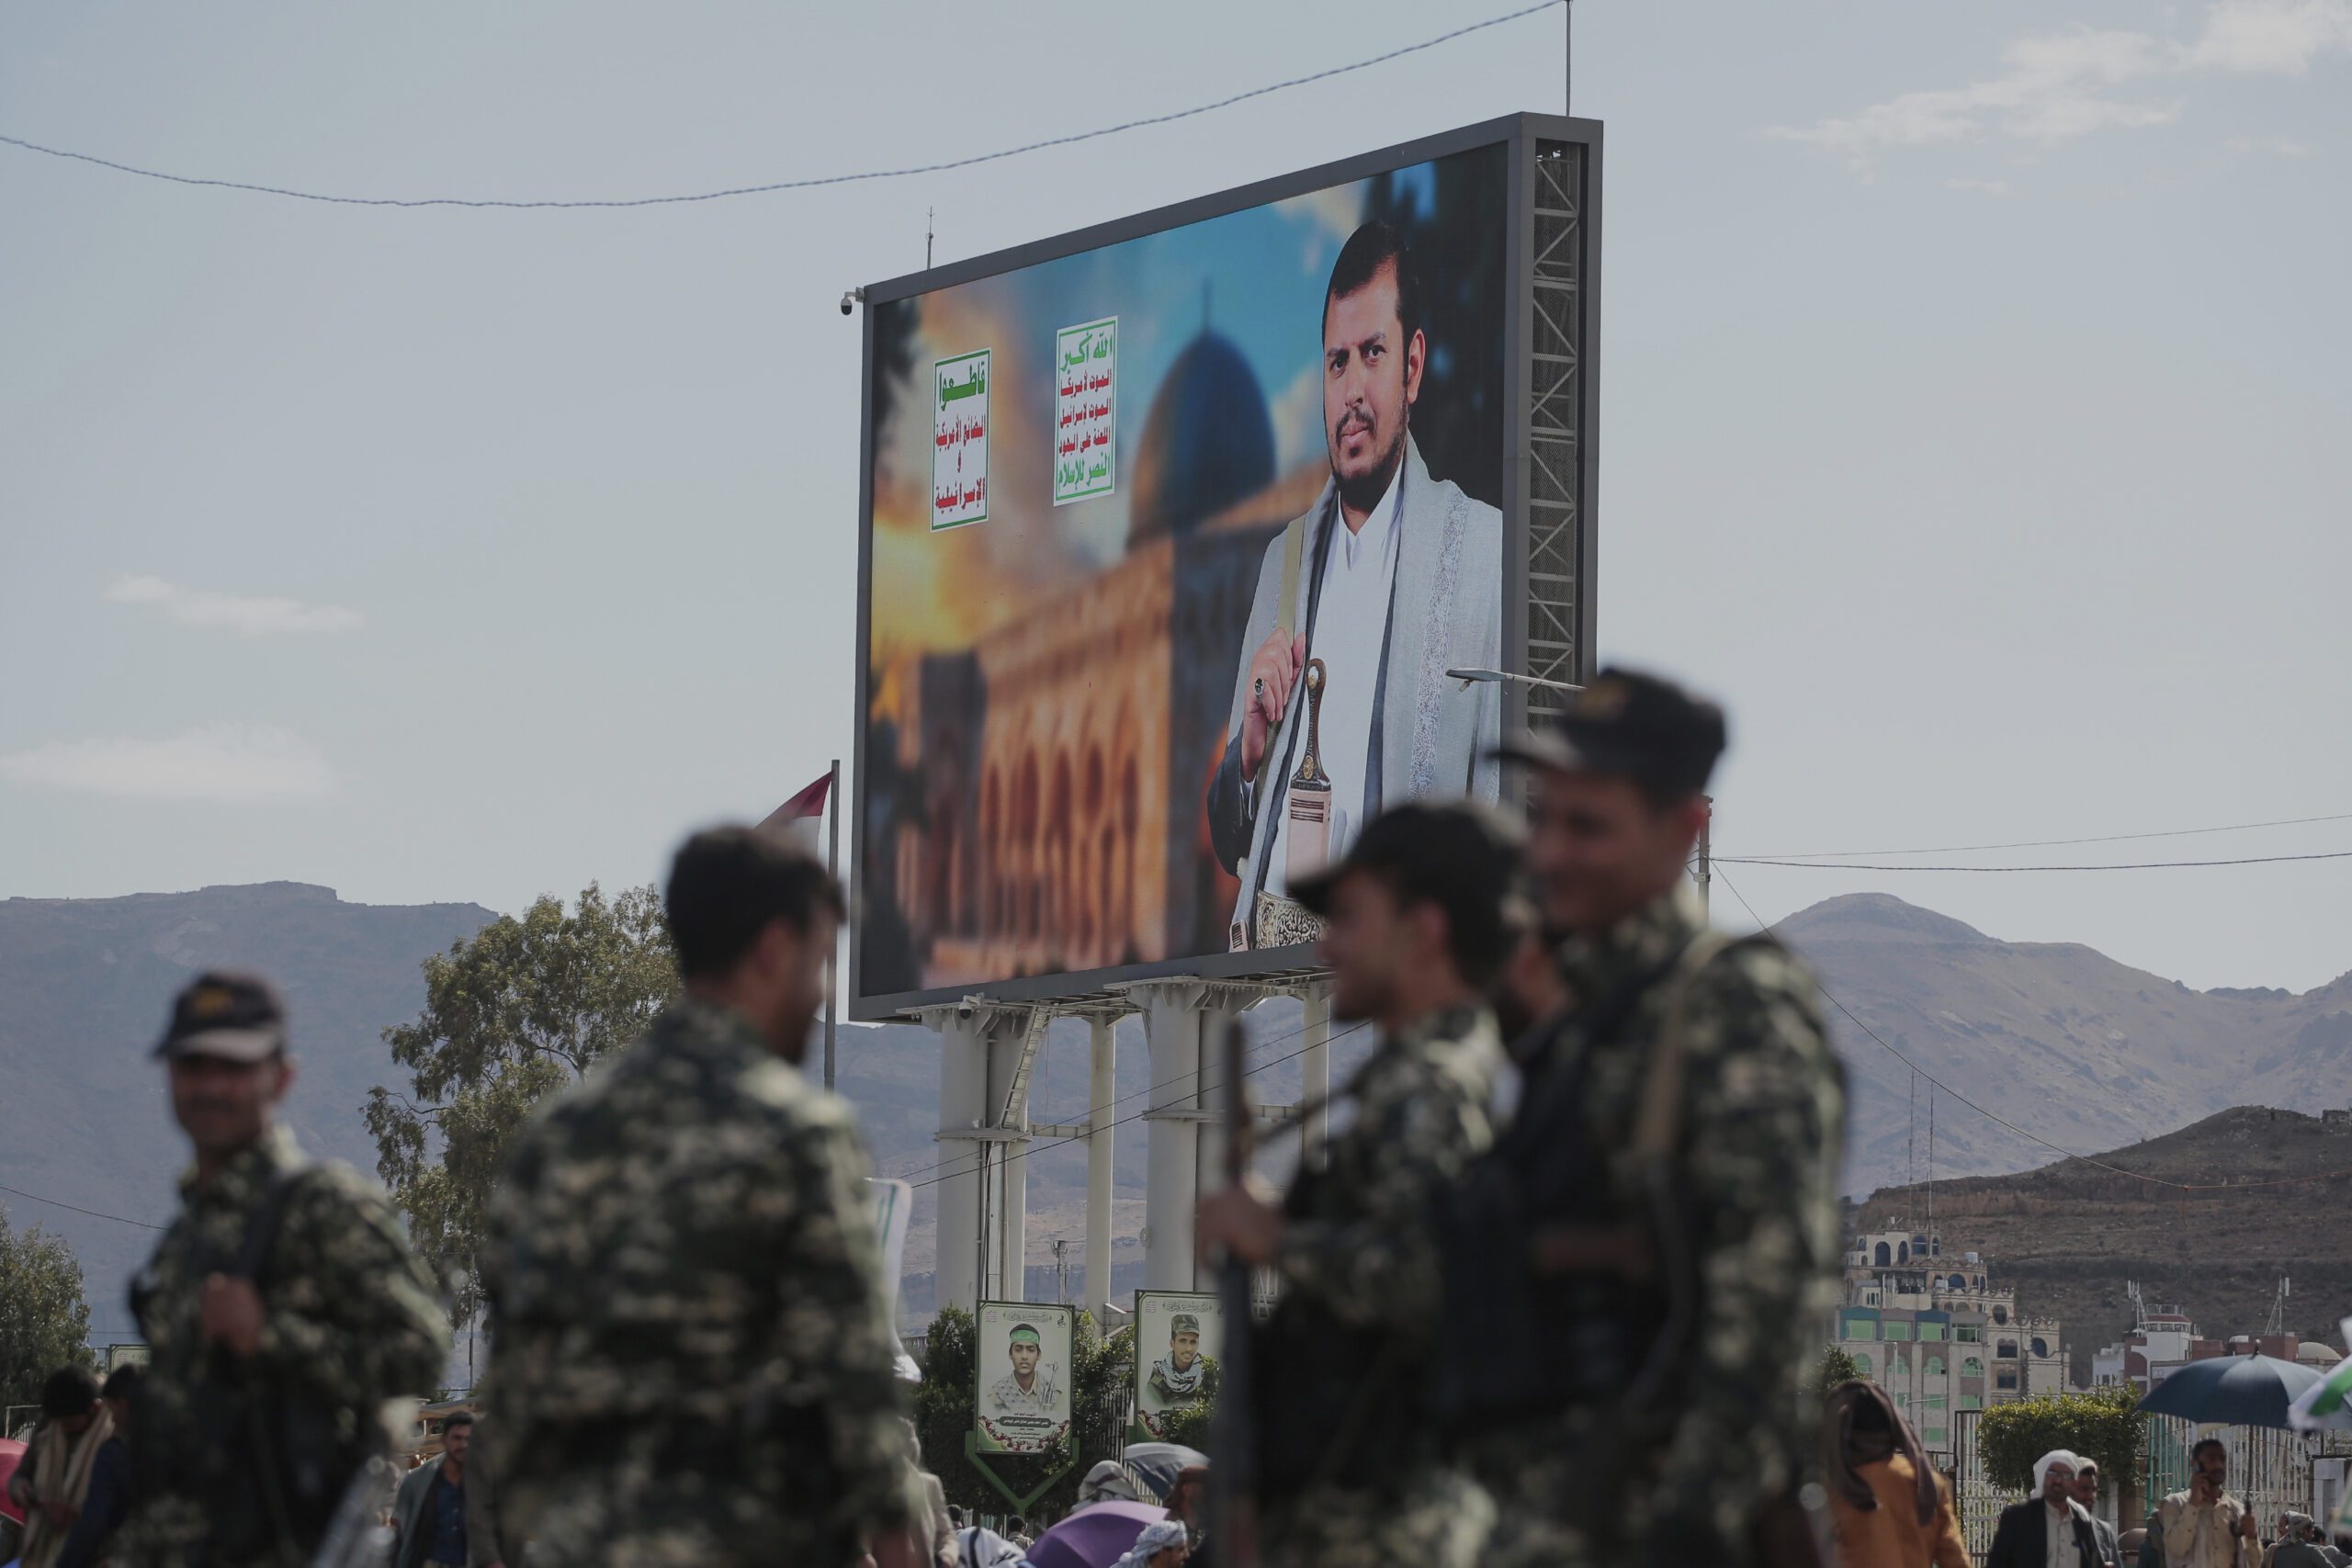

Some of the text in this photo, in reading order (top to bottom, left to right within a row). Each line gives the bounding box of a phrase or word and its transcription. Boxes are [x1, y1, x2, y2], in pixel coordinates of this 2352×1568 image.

[1059, 331, 1113, 375] الله أكبر
[939, 360, 986, 412] قاطعوا
[1089, 367, 1112, 393] الموت
[1089, 396, 1112, 422] الموت
[963, 413, 986, 447] البضائع
[1058, 425, 1111, 457] اللعنة على اليهود
[956, 449, 962, 473] و
[1058, 451, 1111, 492] النصر للإسلام
